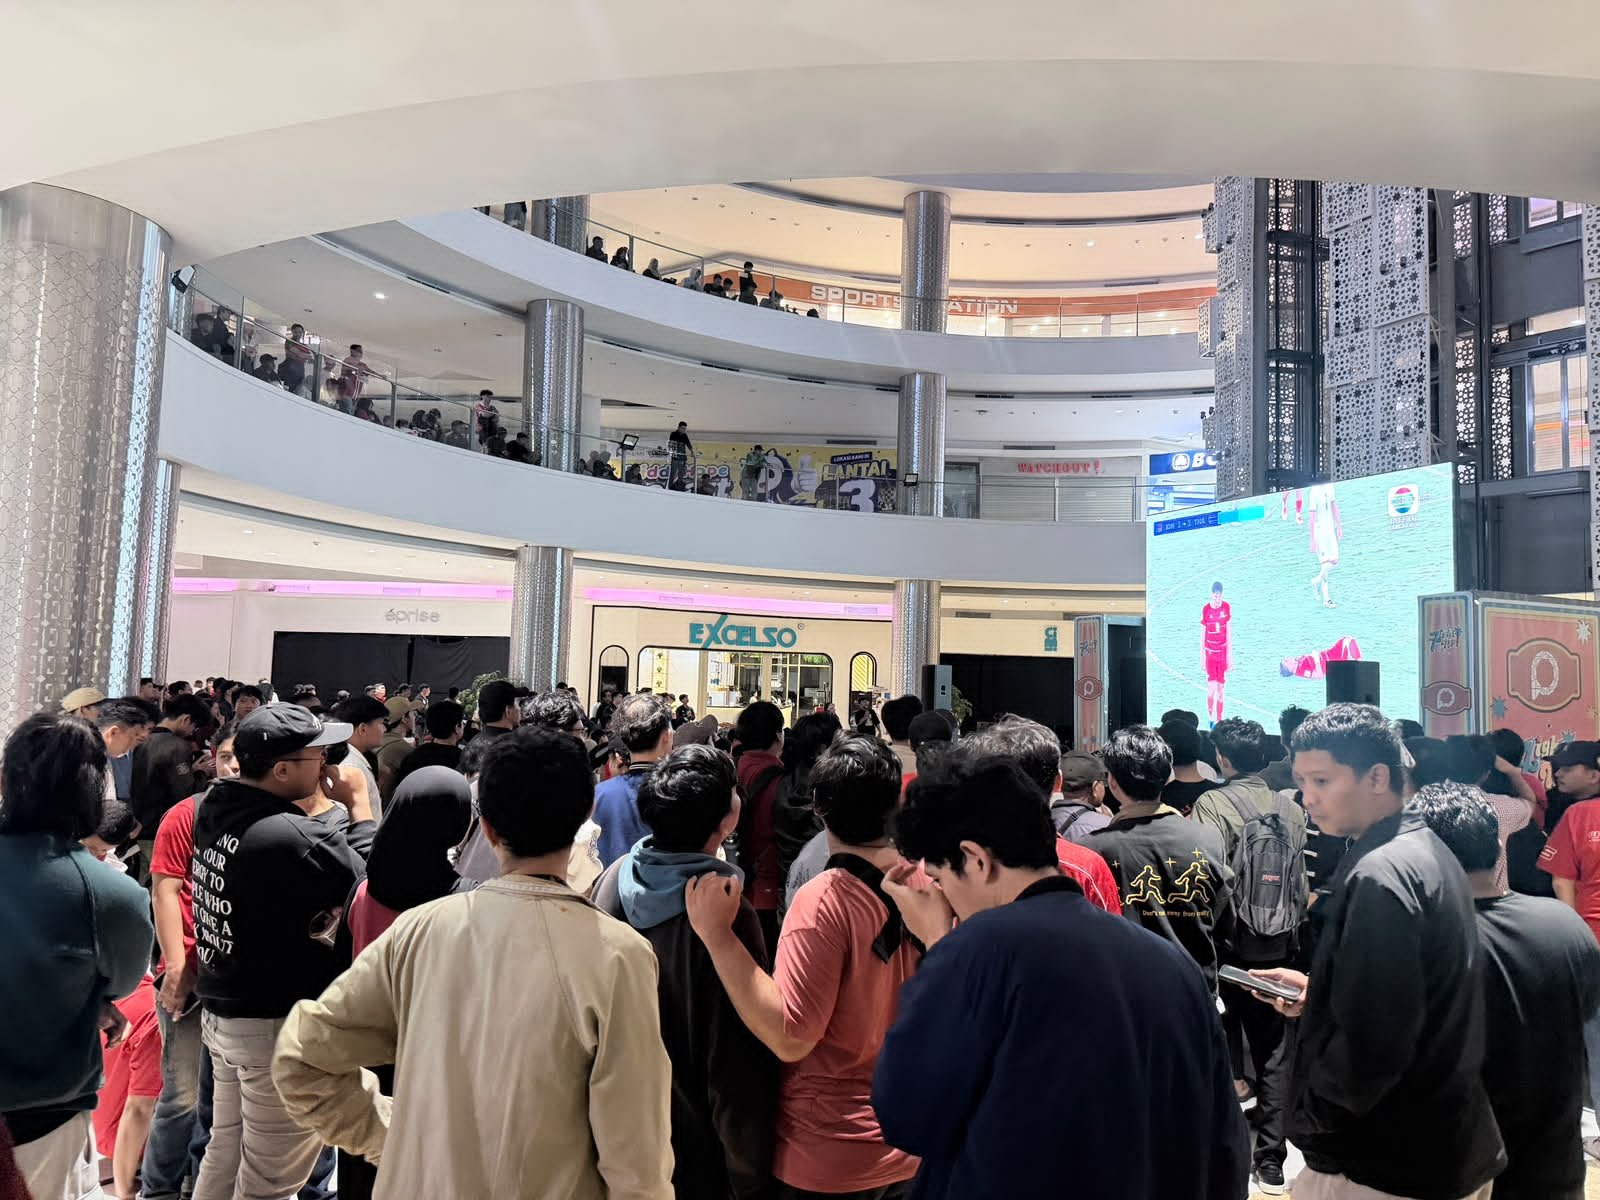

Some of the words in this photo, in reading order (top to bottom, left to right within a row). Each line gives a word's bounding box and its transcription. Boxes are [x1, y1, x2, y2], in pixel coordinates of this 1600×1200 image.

[948, 298, 1018, 314] ATION
[1192, 452, 1217, 467] BC
[823, 460, 887, 480] LANTAI
[840, 479, 876, 513] 3
[689, 614, 797, 649] EXCELSO
[210, 871, 225, 892] TO
[204, 889, 232, 915] WHO
[221, 920, 233, 937] A
